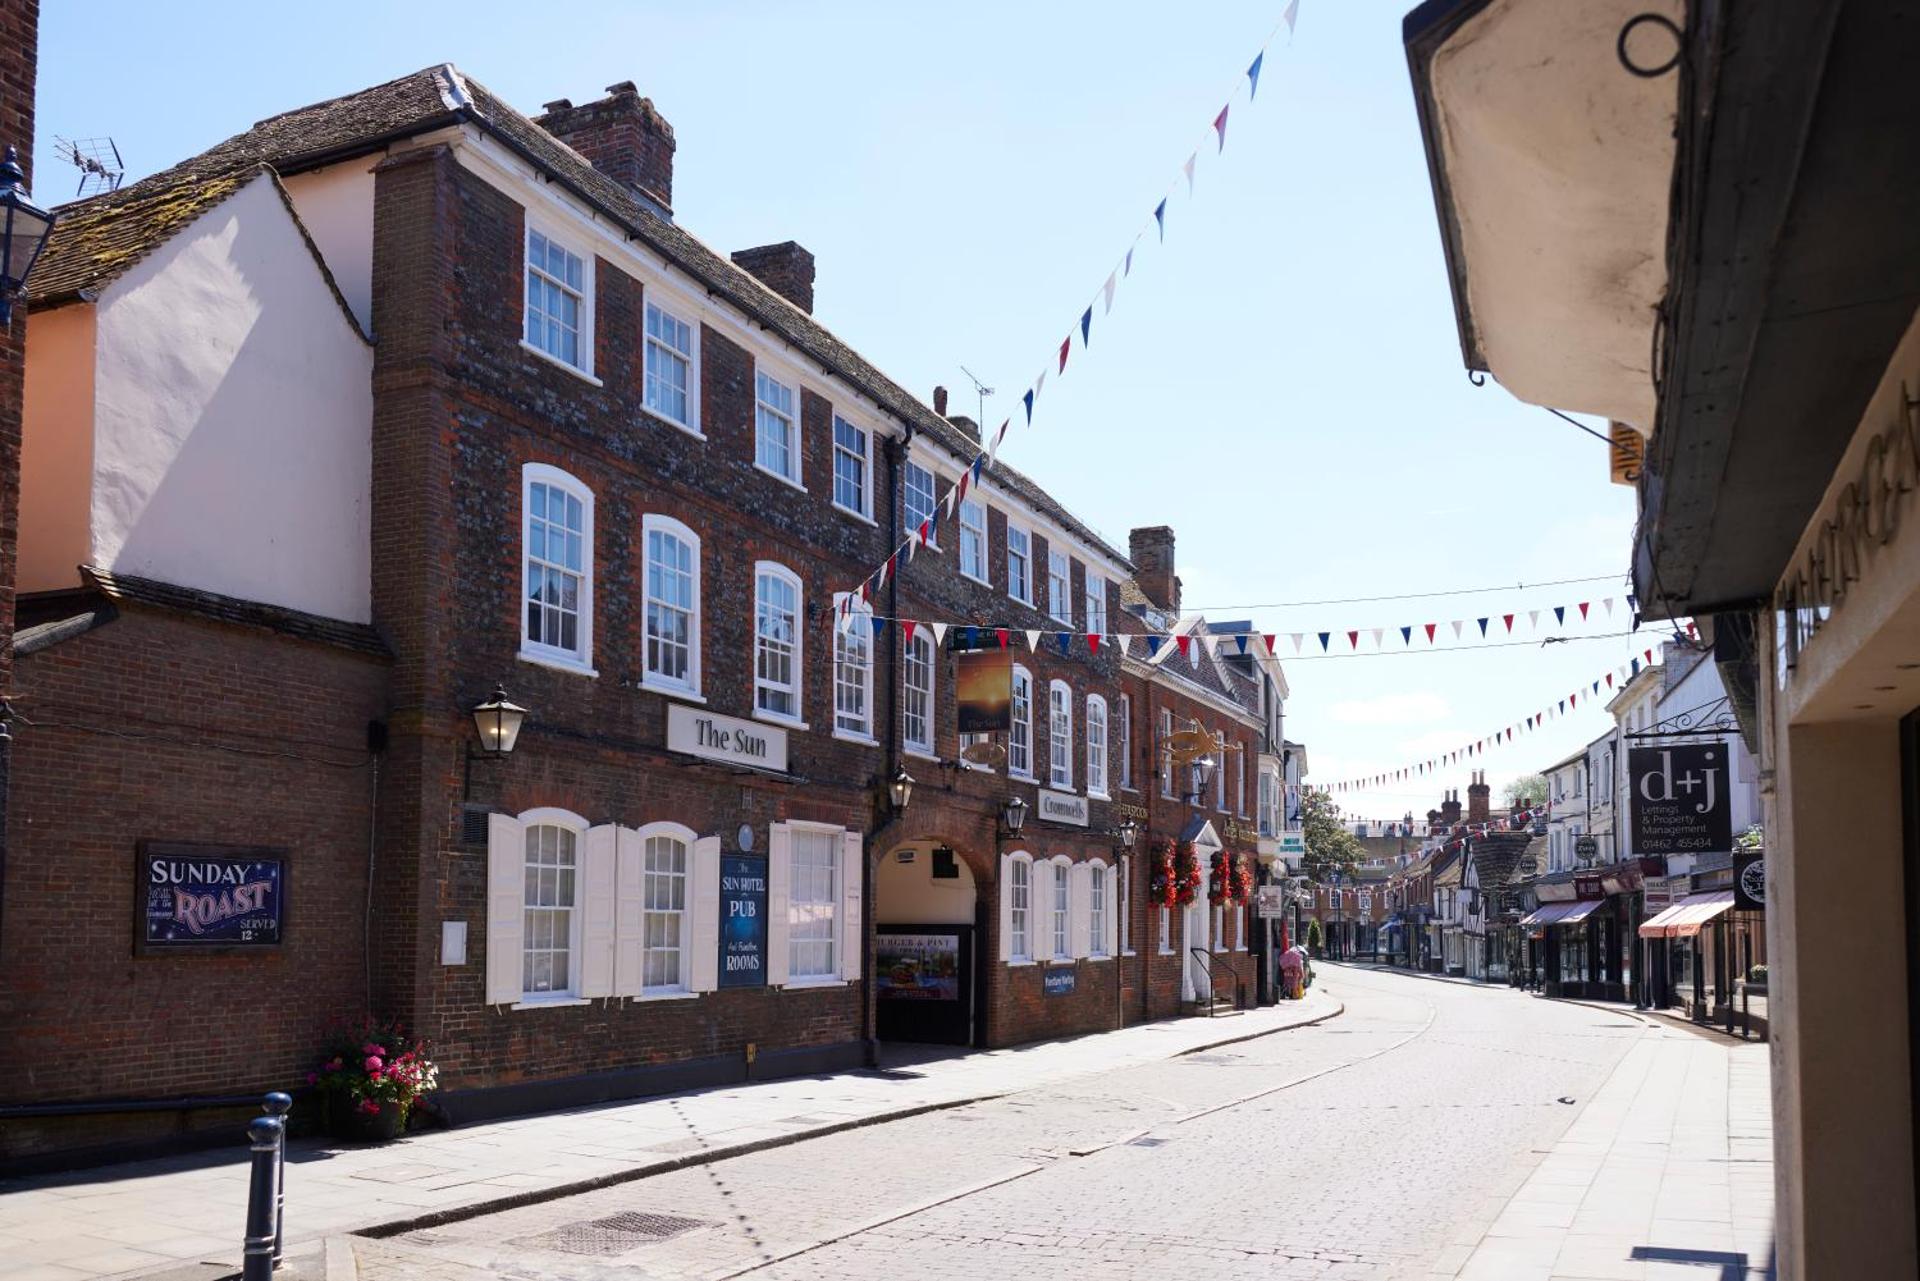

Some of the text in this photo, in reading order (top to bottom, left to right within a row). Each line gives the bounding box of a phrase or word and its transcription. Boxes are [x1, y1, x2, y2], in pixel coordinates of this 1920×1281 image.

[695, 719, 767, 758] The Sun
[1640, 751, 1720, 813] d+j
[1044, 796, 1085, 819] Cromwells
[1641, 804, 1679, 816] Lettings
[1641, 815, 1696, 826] & Property
[1641, 825, 1707, 837] Management
[1641, 838, 1672, 850] 01462
[151, 860, 249, 884] SUNDAY
[722, 876, 766, 892] SUN HOTEL
[173, 880, 273, 935] ROAST
[729, 900, 756, 917] PUB
[240, 918, 276, 930] SERVED
[726, 955, 760, 971] ROOMS
